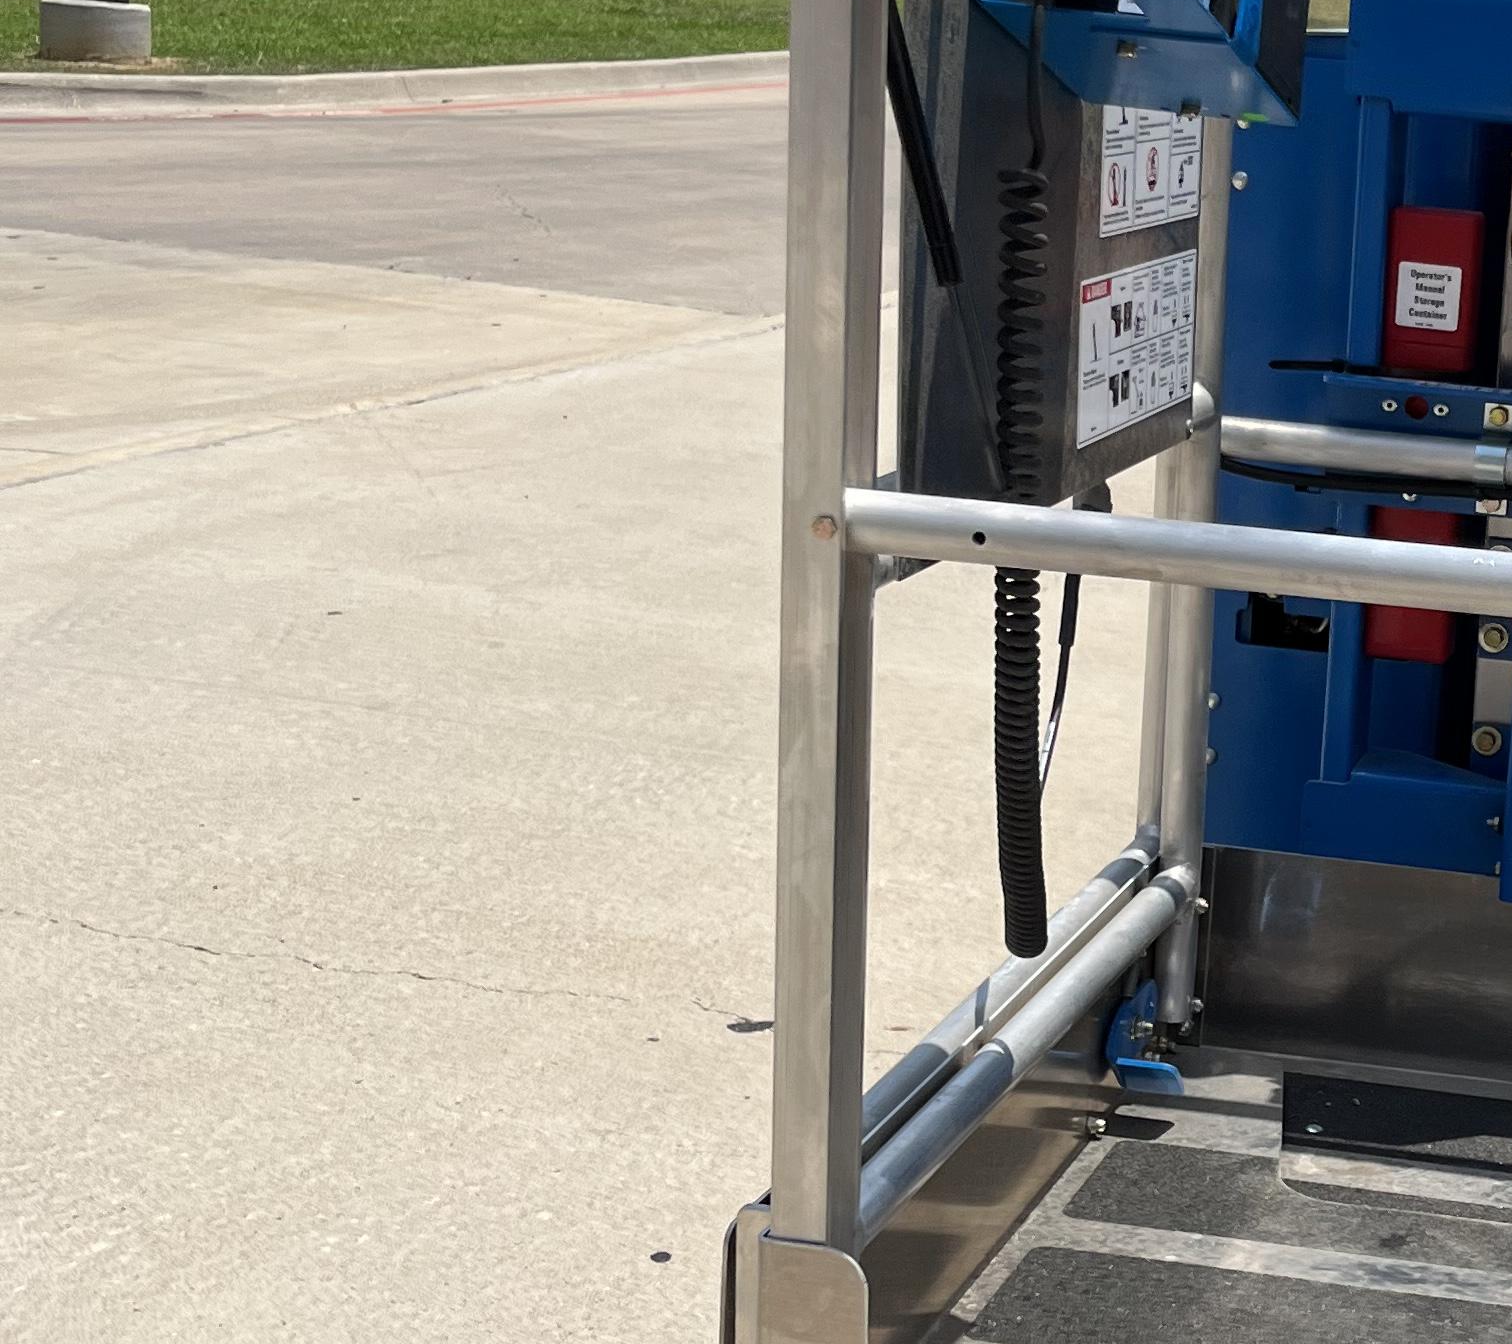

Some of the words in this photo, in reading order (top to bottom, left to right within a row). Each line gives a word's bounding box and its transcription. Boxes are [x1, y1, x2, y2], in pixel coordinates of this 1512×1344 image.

[1415, 283, 1446, 294] Manual
[1414, 295, 1445, 308] Storage
[1408, 307, 1448, 320] Container
